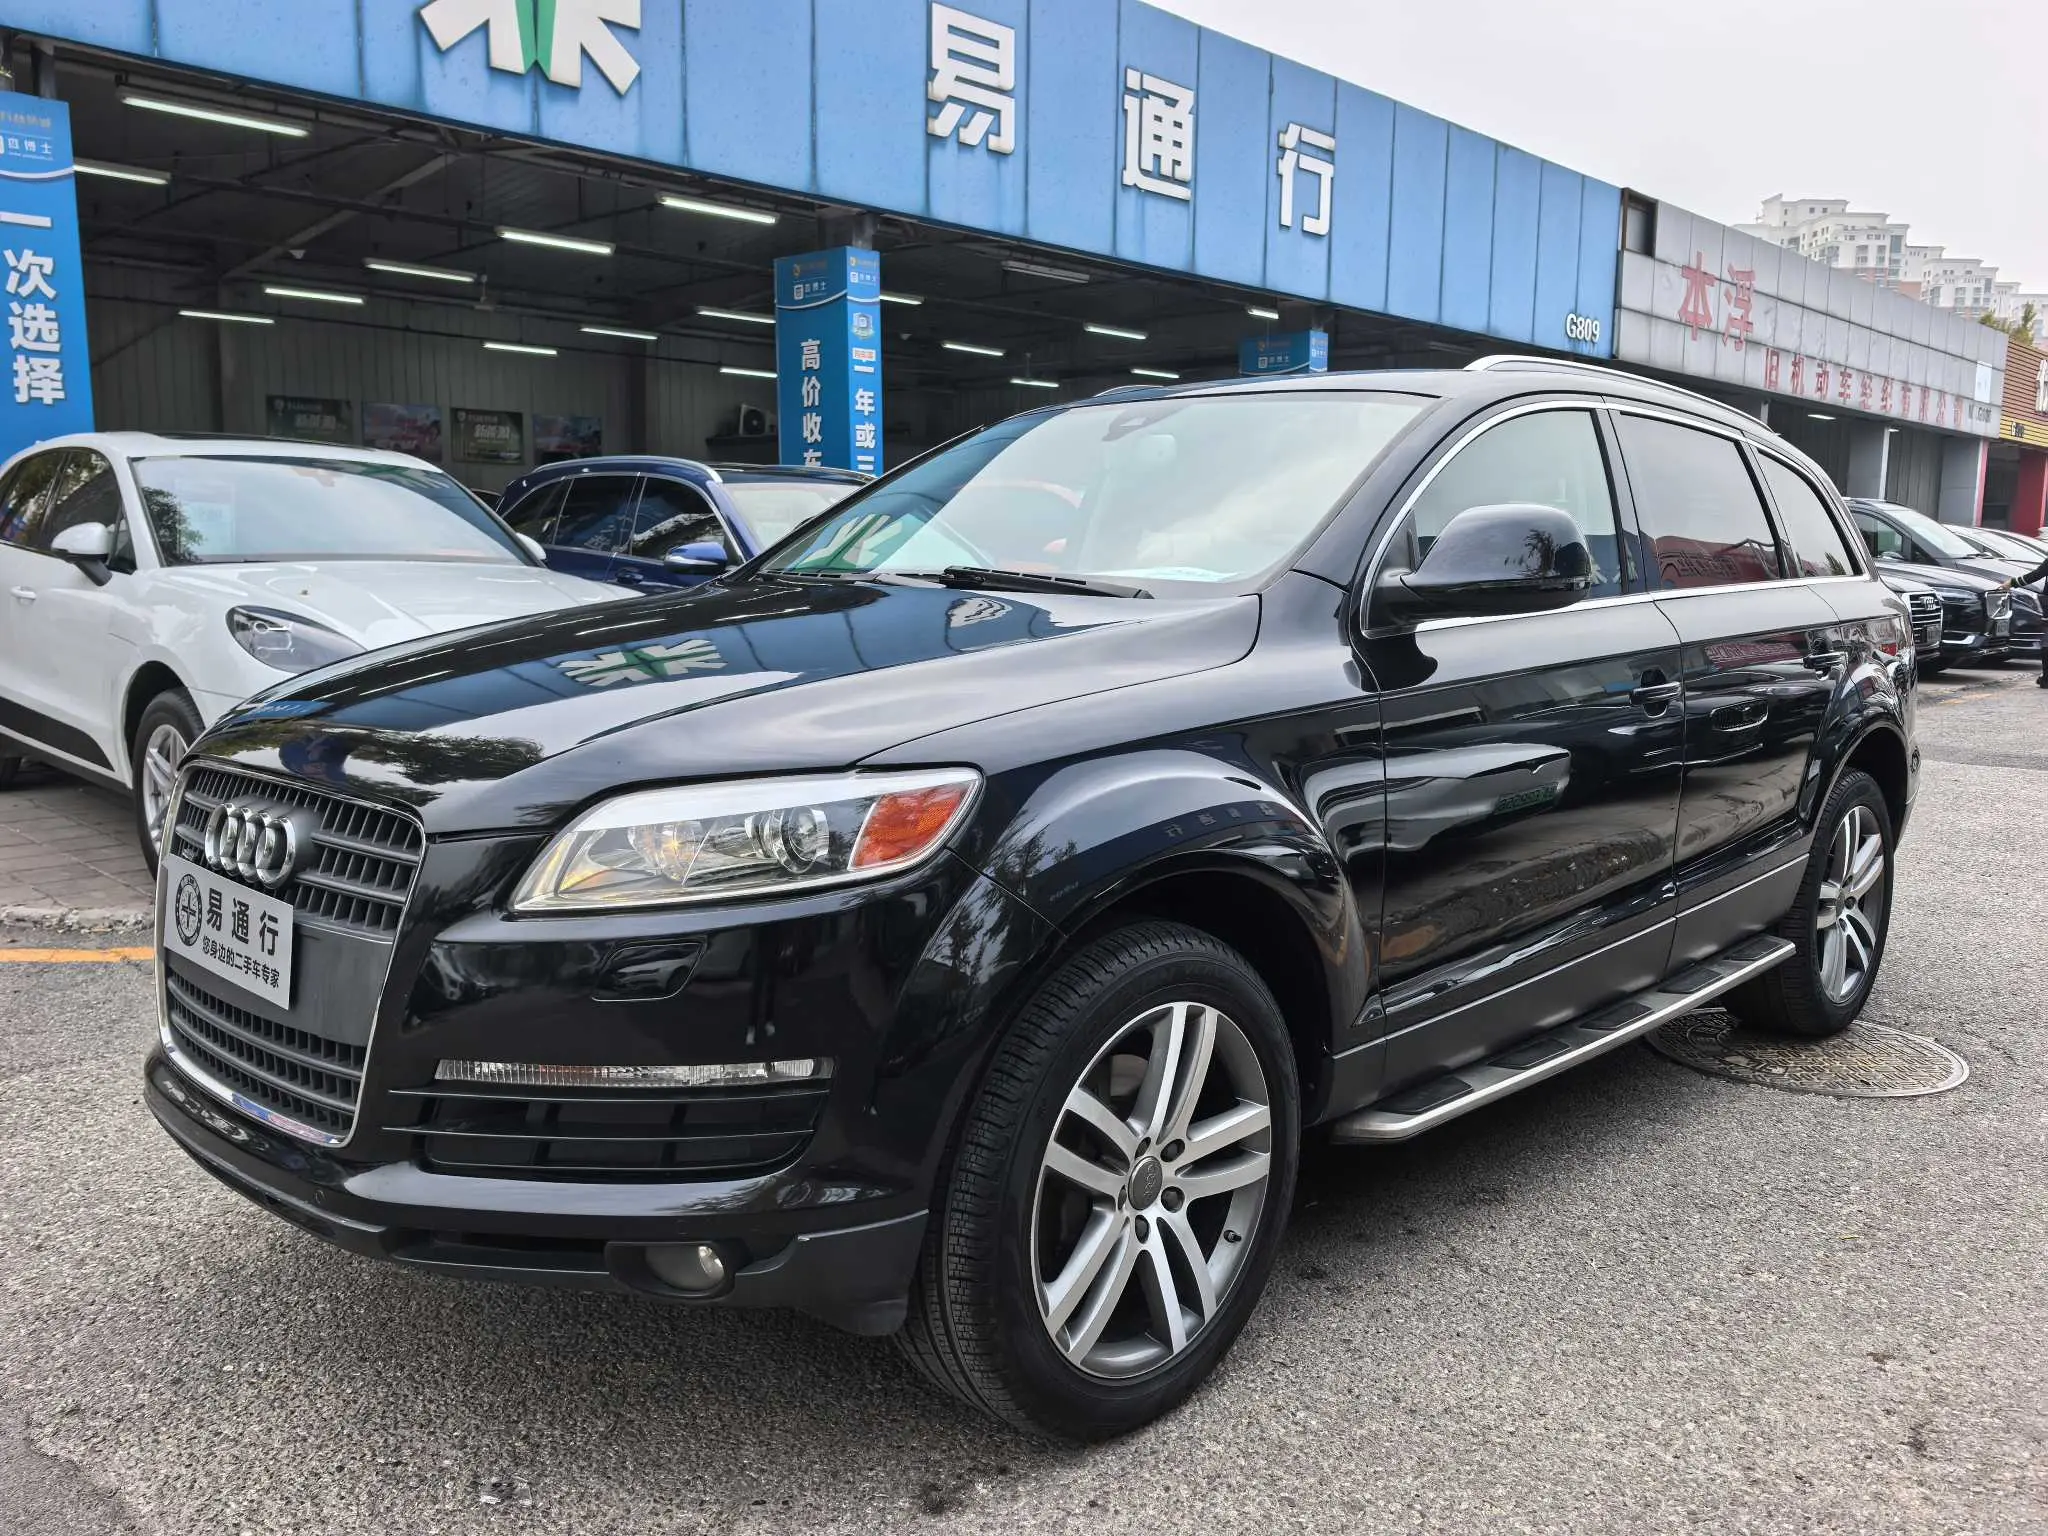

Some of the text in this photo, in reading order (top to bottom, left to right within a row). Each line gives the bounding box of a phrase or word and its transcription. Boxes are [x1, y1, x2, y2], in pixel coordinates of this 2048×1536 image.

[927, 2, 1335, 236] 易通行
[0, 211, 65, 405] 一次选择
[1566, 313, 1600, 343] G809
[801, 339, 822, 467] 高价收车
[202, 935, 280, 988] 您身边的二手车专家
[206, 887, 279, 956] 易通行
